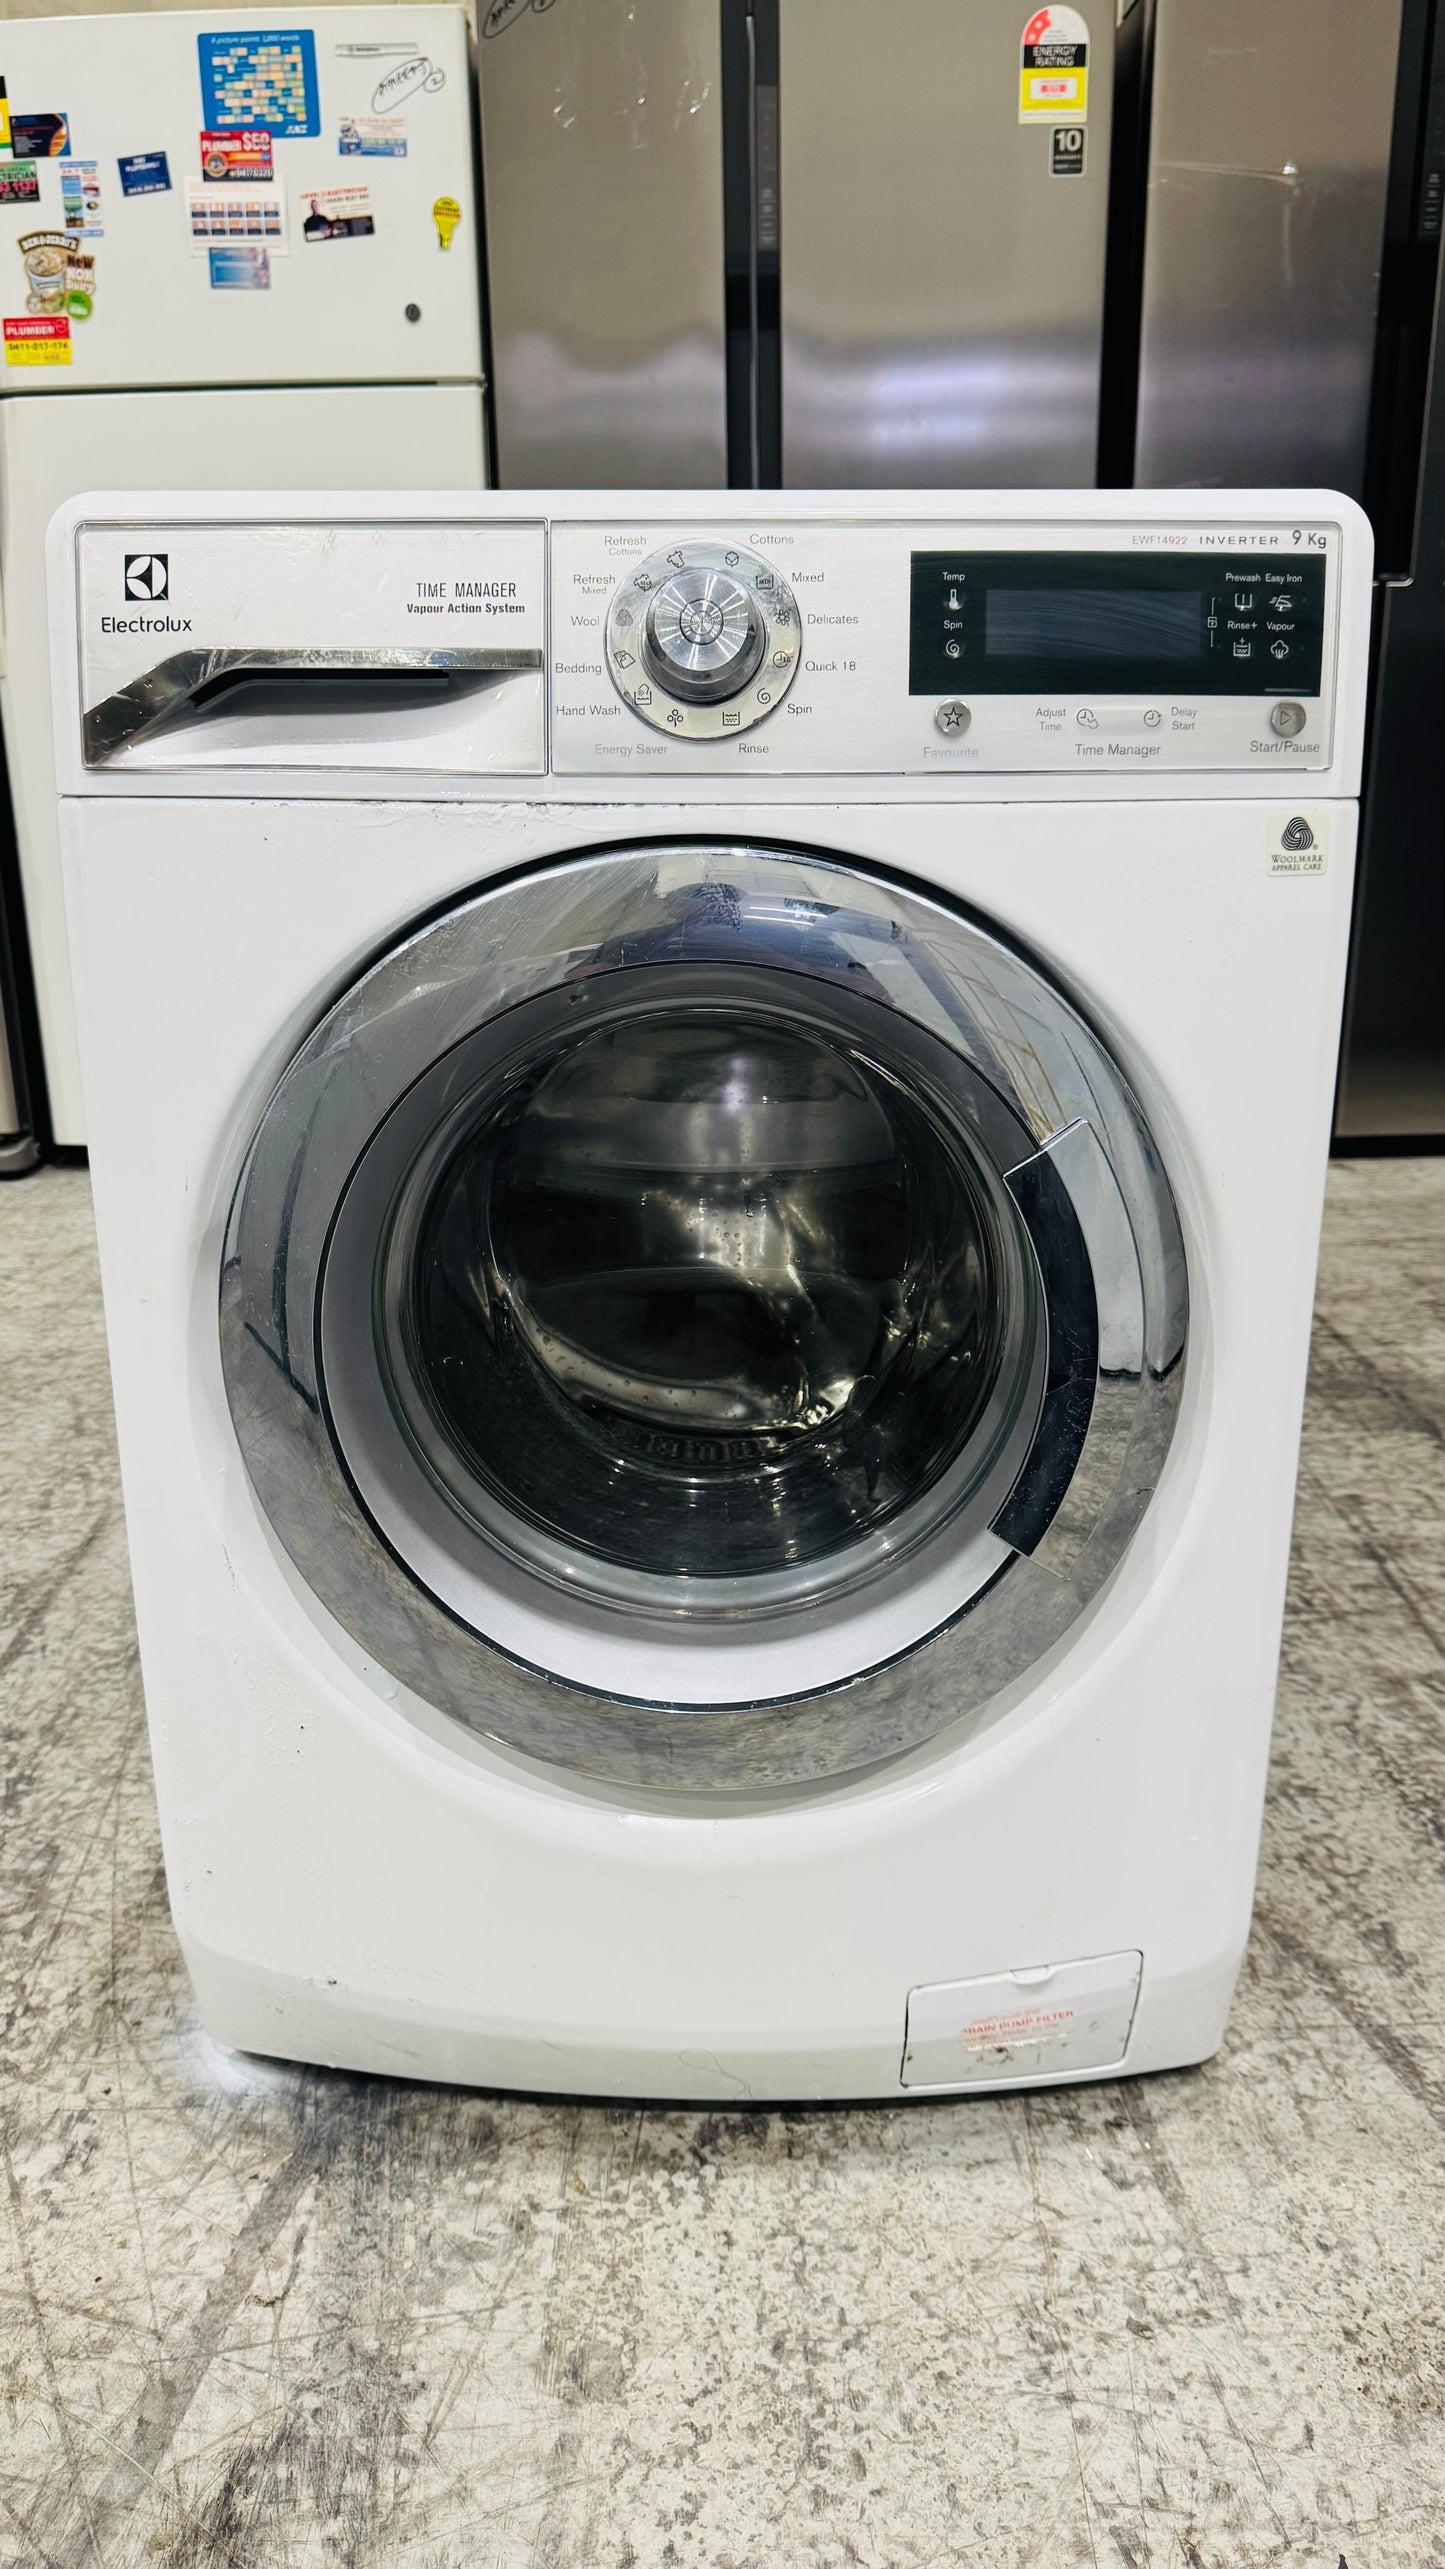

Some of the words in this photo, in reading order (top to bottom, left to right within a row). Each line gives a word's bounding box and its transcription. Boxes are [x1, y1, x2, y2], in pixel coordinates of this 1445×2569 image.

[1032, 45, 1078, 57] ENERGY
[1035, 56, 1075, 67] RATING
[1055, 130, 1083, 151] 10
[6, 325, 55, 336] PLUMBER
[604, 535, 647, 546] Refresh
[749, 533, 794, 545] Cottons
[1132, 535, 1188, 545] EWF14922
[1199, 535, 1279, 546] INVERTER
[1292, 529, 1302, 546] 9
[1307, 532, 1327, 550] Kg
[608, 547, 643, 556] Cottons
[573, 573, 616, 585] Refresh
[791, 571, 825, 583] Mixed
[942, 571, 966, 583] Temp
[1225, 572, 1261, 582] Prewash
[1265, 573, 1284, 585] Easy
[1285, 573, 1303, 583] Iron
[416, 582, 447, 598] TIME
[455, 582, 517, 598] MANAGER
[582, 585, 607, 595] Mixed
[406, 603, 444, 616] Vapour
[447, 603, 482, 614] Action
[485, 603, 525, 616] System
[101, 615, 193, 634] Electrolux
[570, 615, 600, 627] Wool
[807, 613, 859, 625] Delicates
[943, 619, 963, 631] Spin
[1266, 621, 1296, 632] Vapour
[555, 662, 602, 676] Bedding
[804, 660, 838, 672] Quick
[843, 660, 857, 672] 18
[556, 705, 586, 716] Hand
[589, 704, 621, 716] Wash
[787, 703, 813, 717] Spin
[1035, 707, 1066, 720] Adjust
[1170, 707, 1198, 720] Delay
[1039, 721, 1063, 731] Time
[1171, 720, 1195, 731] Start
[594, 743, 633, 758] Energy
[636, 743, 668, 755] Saver
[738, 742, 769, 754] Rinse
[1074, 743, 1104, 756] Time
[1107, 743, 1161, 759] Manager
[1249, 739, 1321, 753] Start/Pause
[923, 746, 979, 759] Favourite
[1271, 854, 1324, 863] WOOLMARK
[1271, 864, 1302, 872] APPAREL
[1036, 2010, 1074, 2024] FILTER
